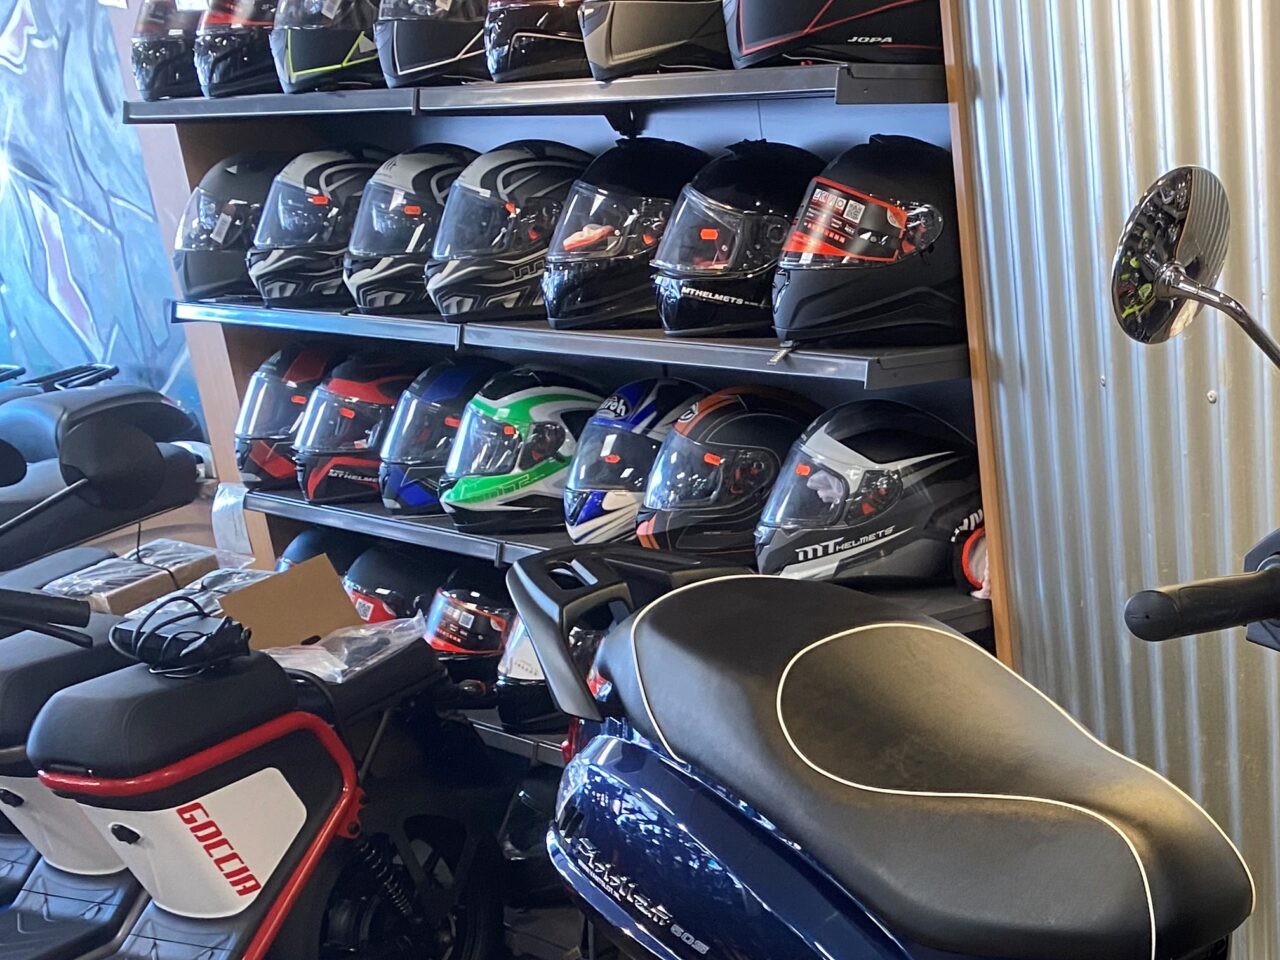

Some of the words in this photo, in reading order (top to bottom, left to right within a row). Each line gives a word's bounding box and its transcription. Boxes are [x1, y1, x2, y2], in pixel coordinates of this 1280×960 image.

[795, 536, 844, 561] MT
[835, 525, 896, 552] HELMETS
[175, 801, 262, 897] GOCCIA
